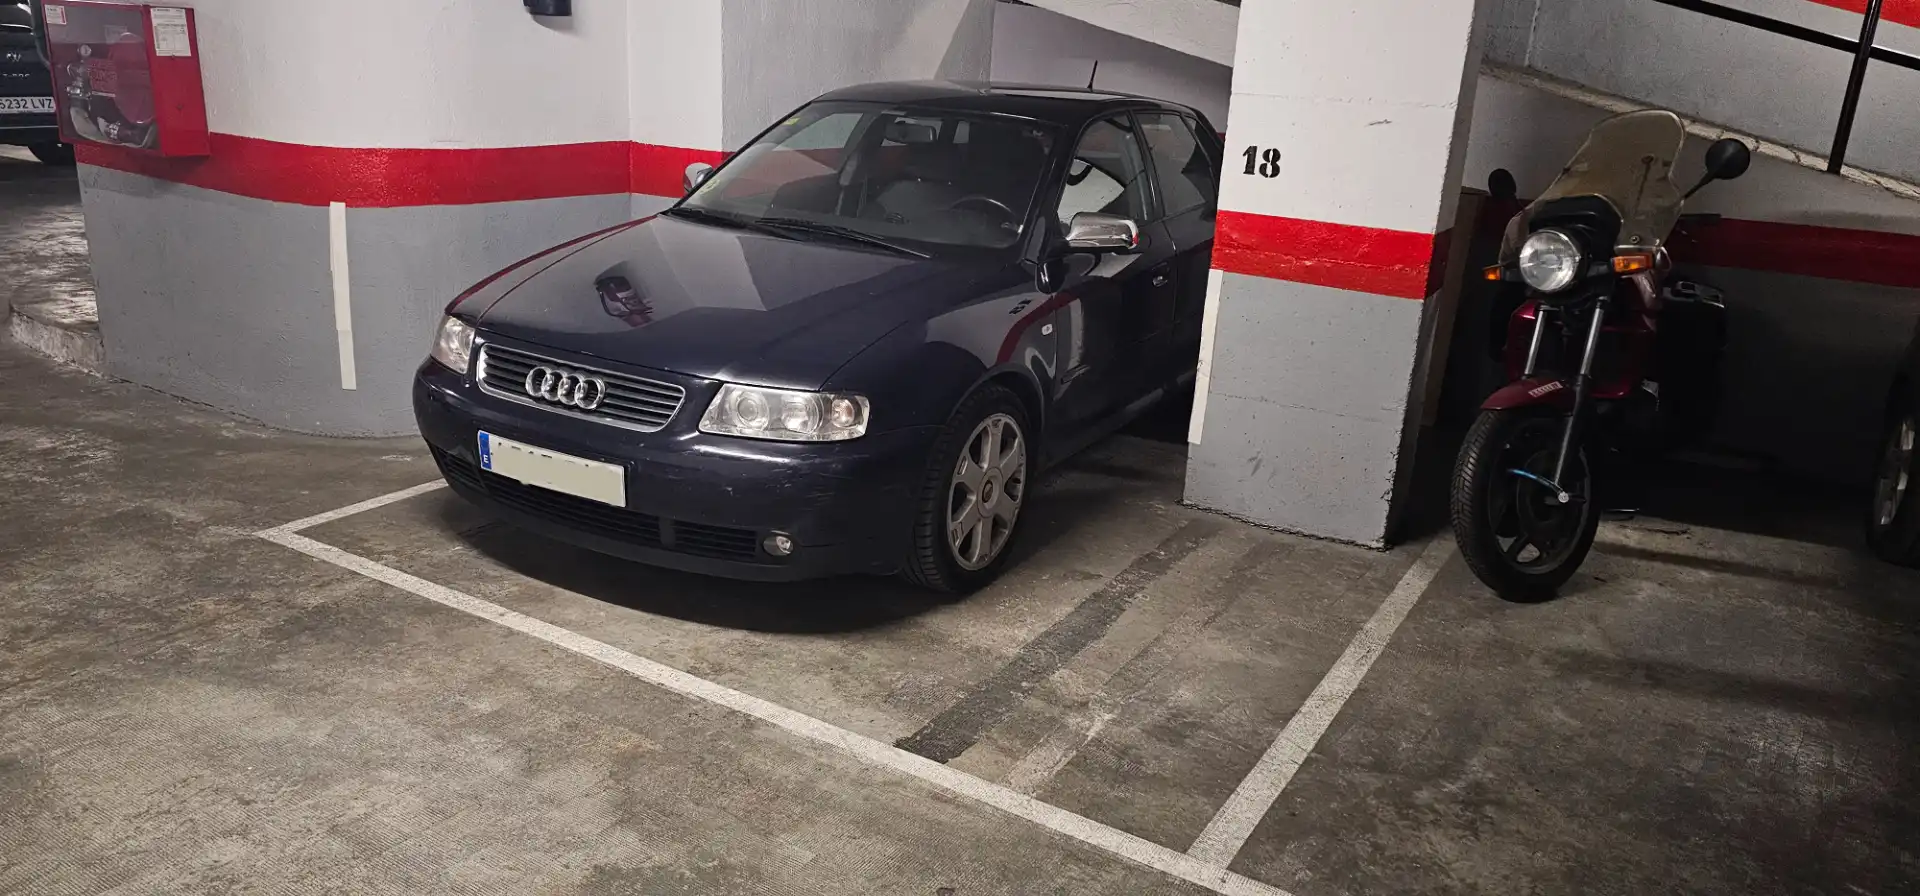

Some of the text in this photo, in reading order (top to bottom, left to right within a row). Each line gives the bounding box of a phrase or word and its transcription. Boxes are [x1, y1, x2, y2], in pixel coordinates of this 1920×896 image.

[30, 98, 54, 109] LVZ
[1242, 145, 1281, 178] 18
[483, 454, 489, 464] E
